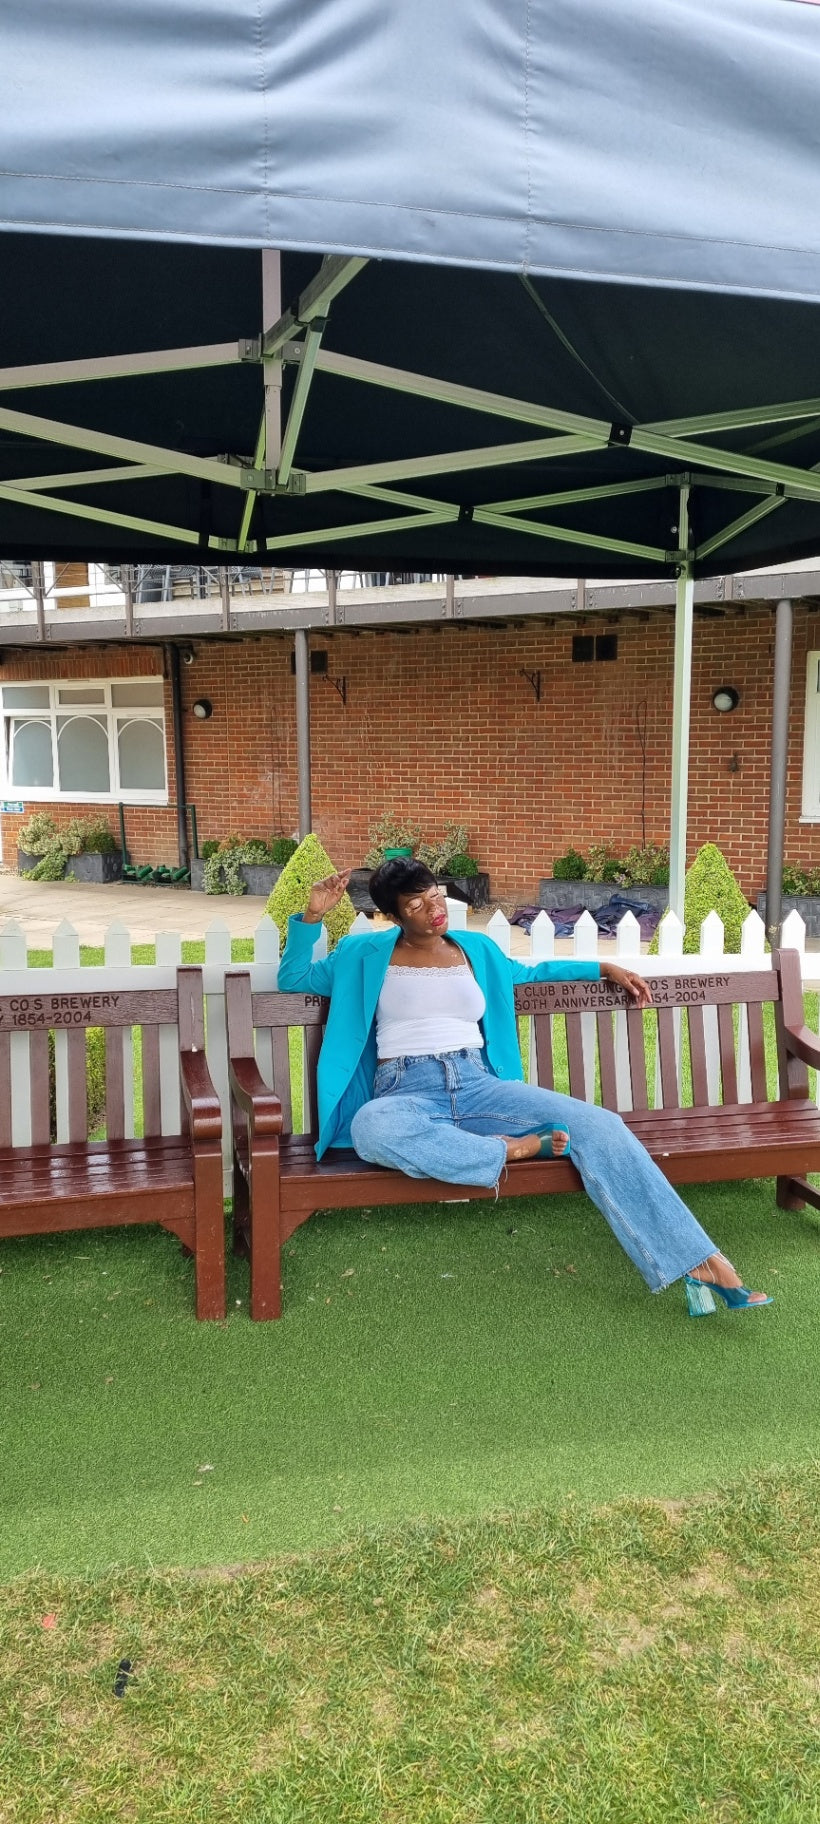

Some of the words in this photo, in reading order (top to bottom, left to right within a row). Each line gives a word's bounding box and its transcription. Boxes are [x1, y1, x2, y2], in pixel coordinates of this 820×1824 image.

[524, 985, 555, 997] CLUB
[562, 984, 577, 995] BY
[582, 983, 623, 994] YOUNG
[675, 977, 730, 989] BREWERY
[51, 996, 120, 1009] BREWERY
[12, 1011, 92, 1026] 1854-2004
